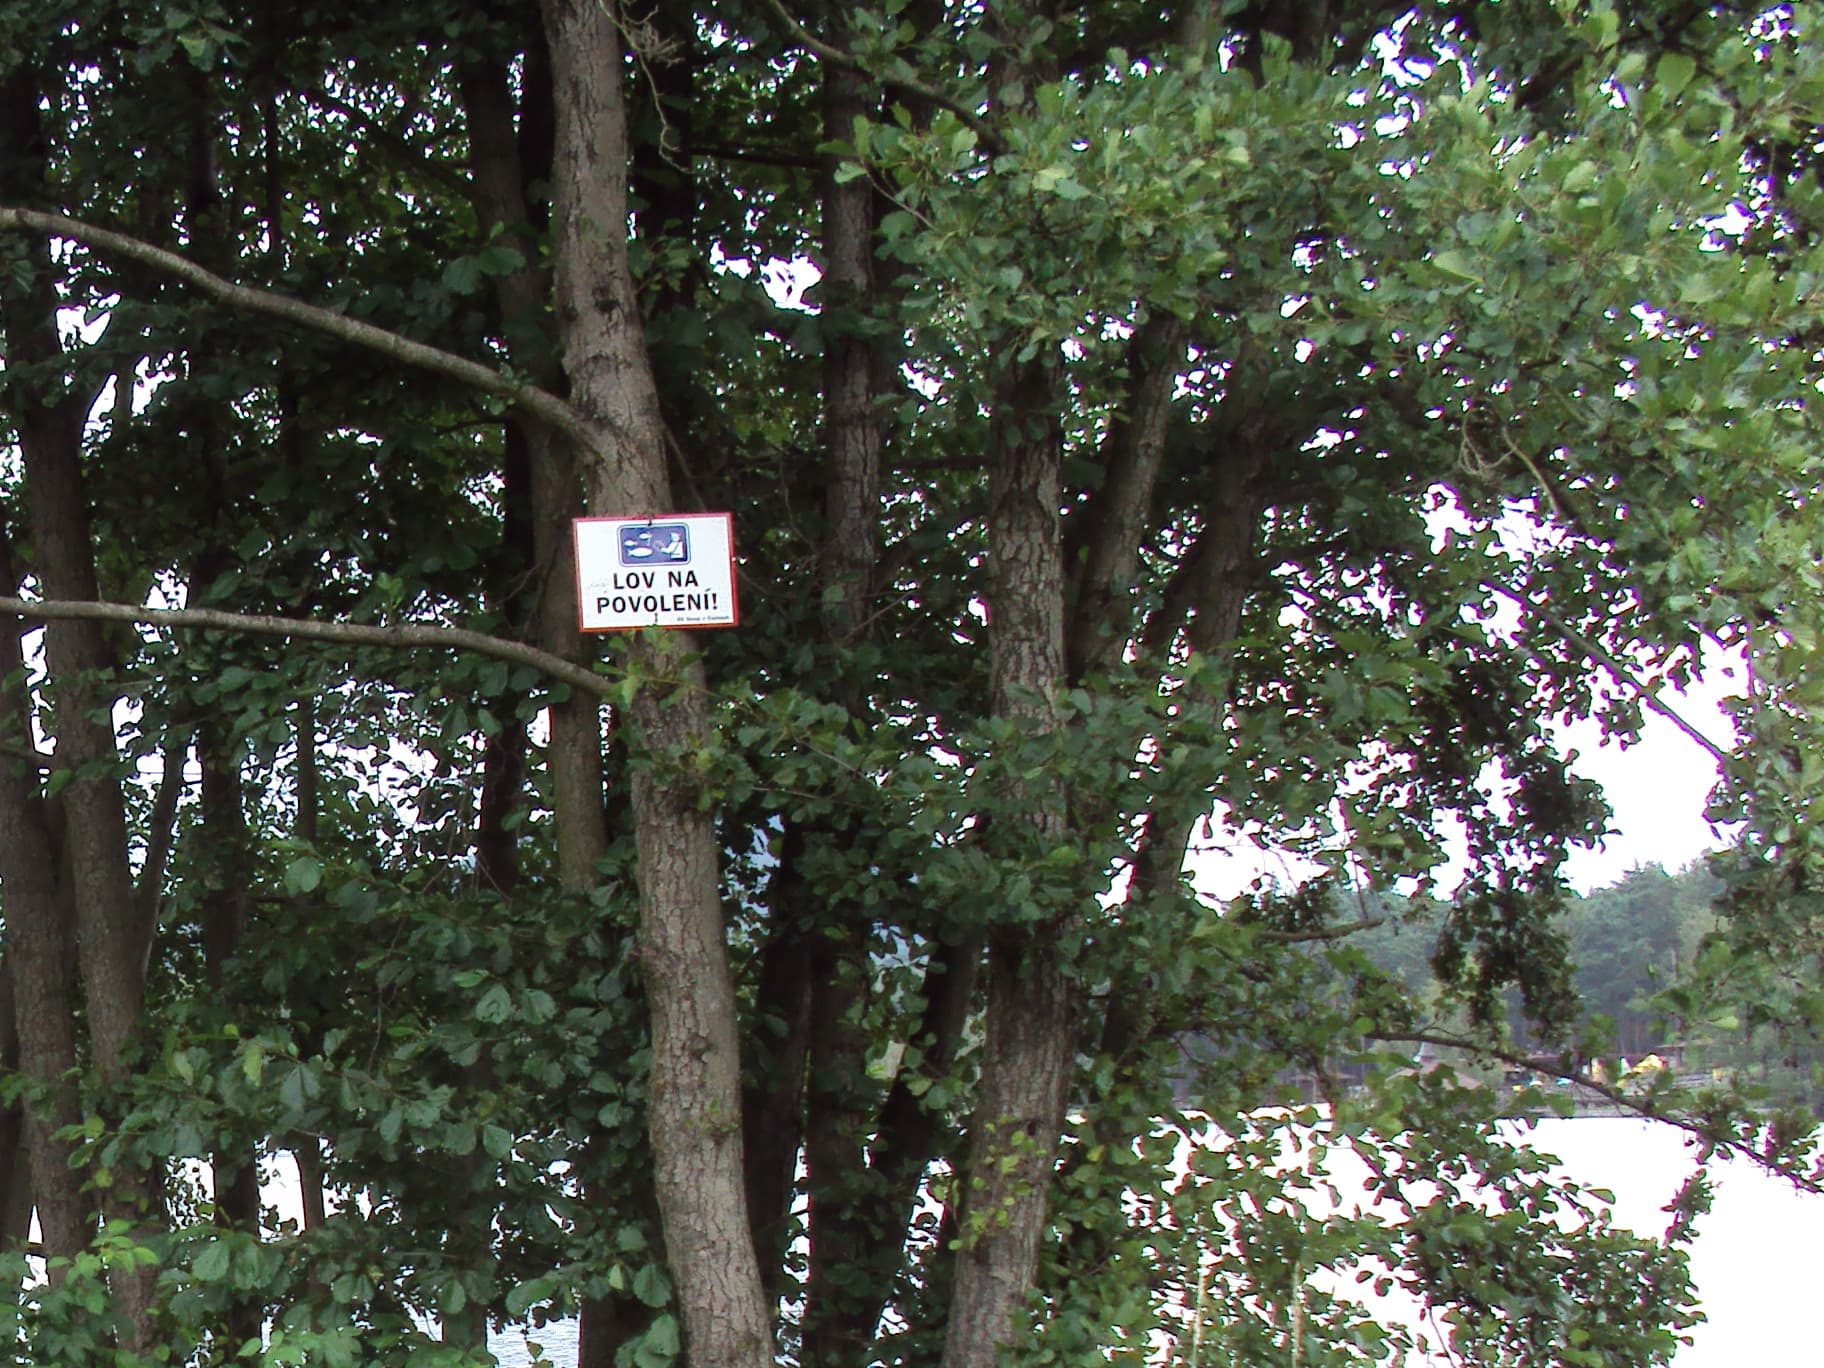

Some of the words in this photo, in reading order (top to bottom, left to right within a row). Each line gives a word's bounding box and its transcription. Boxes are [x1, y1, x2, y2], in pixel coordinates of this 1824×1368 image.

[613, 572, 655, 590] LOV
[668, 570, 699, 588] NA
[596, 589, 718, 614] POVOLENÍ!
